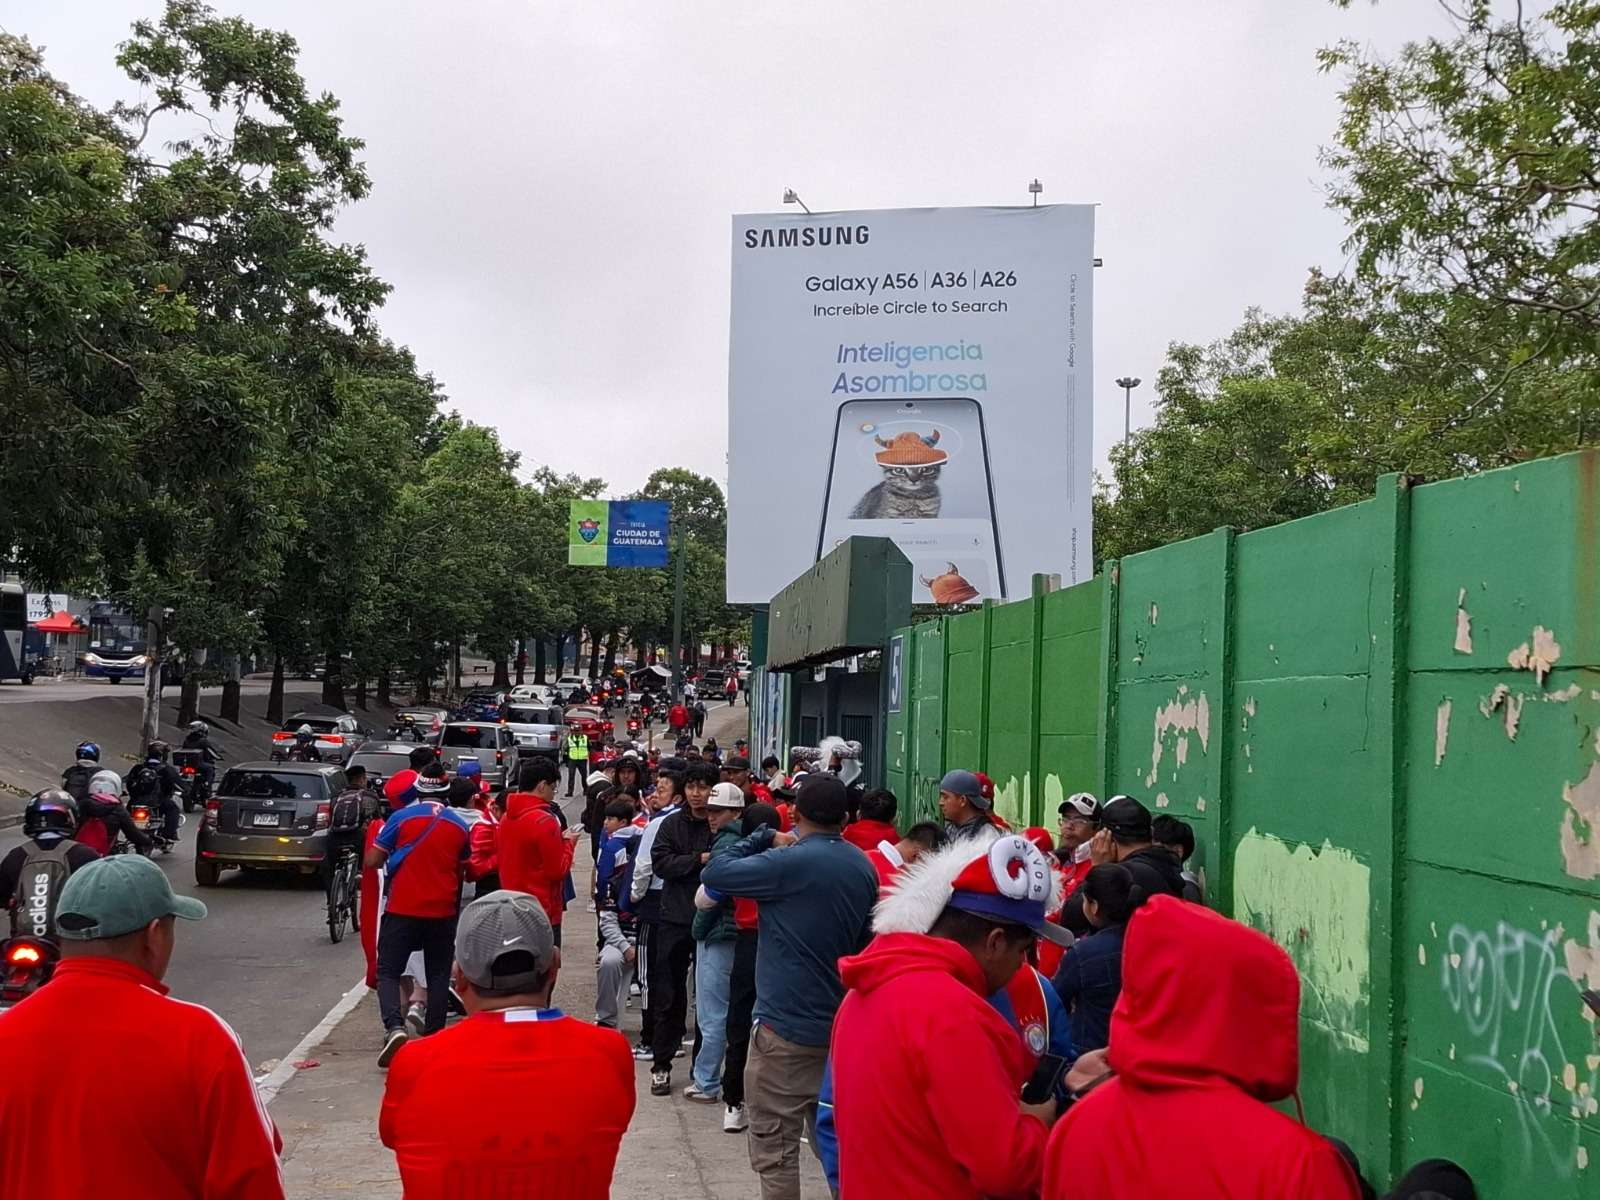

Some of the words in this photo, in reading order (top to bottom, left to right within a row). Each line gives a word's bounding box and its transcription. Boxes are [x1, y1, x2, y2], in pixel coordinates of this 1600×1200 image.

[745, 225, 869, 248] SAMSUNG
[805, 275, 879, 295] Galaxy
[882, 273, 918, 290] A56
[931, 271, 967, 289] A36
[980, 270, 1017, 288] A26
[883, 301, 927, 314] Circle
[932, 301, 947, 313] to
[951, 300, 1008, 313] Search
[837, 340, 983, 369] Inteligencia
[831, 371, 988, 394] Asombrosa
[613, 538, 664, 546] GUATEMALA
[616, 529, 647, 537] CIUDAD
[649, 530, 660, 538] DE
[891, 645, 900, 705] 5
[29, 873, 49, 936] adidas
